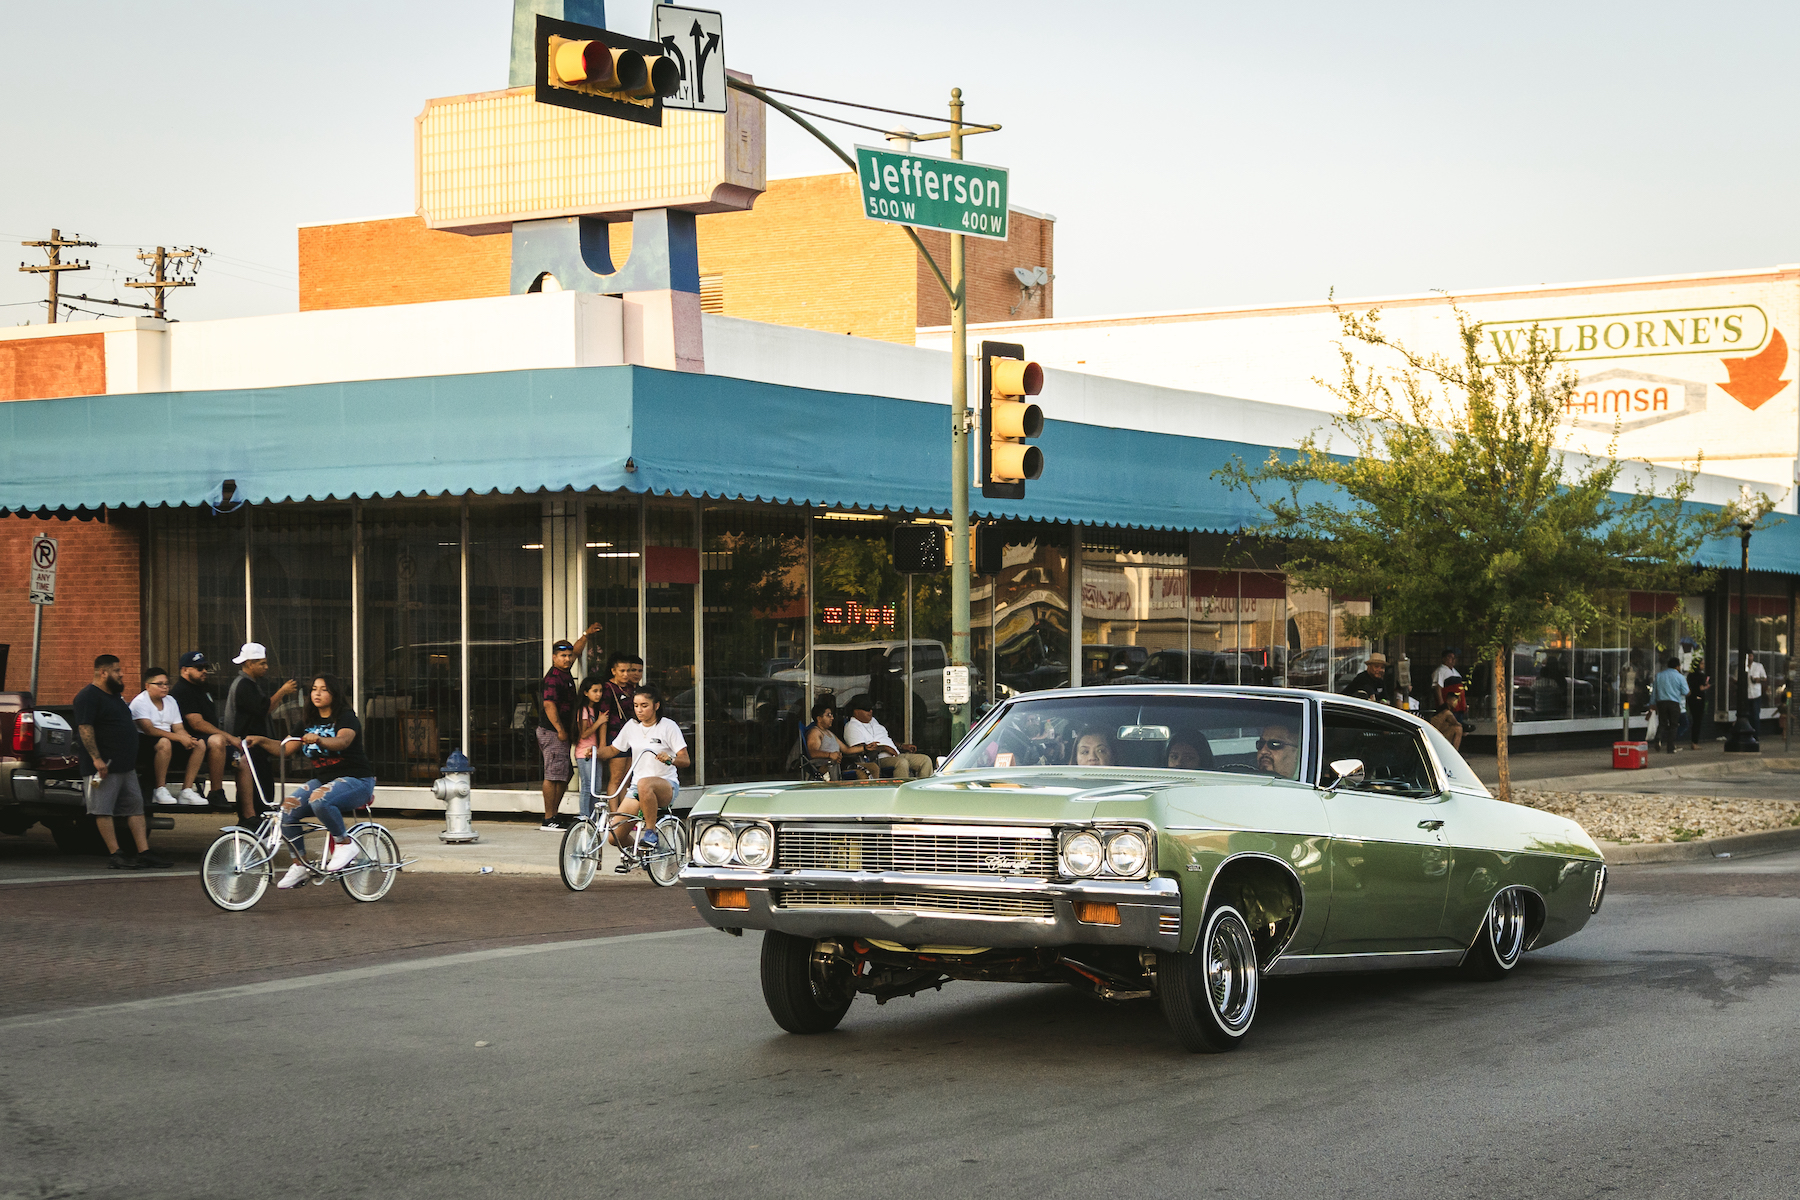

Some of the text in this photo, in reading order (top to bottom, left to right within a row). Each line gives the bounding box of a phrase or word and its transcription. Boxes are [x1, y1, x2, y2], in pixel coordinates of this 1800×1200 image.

[869, 157, 1000, 209] Jefferson
[869, 197, 915, 220] 500 W
[962, 211, 1003, 233] 400 W
[1488, 315, 1743, 356] WELBORNE'S
[35, 581, 50, 592] TIME
[36, 573, 51, 582] ANY
